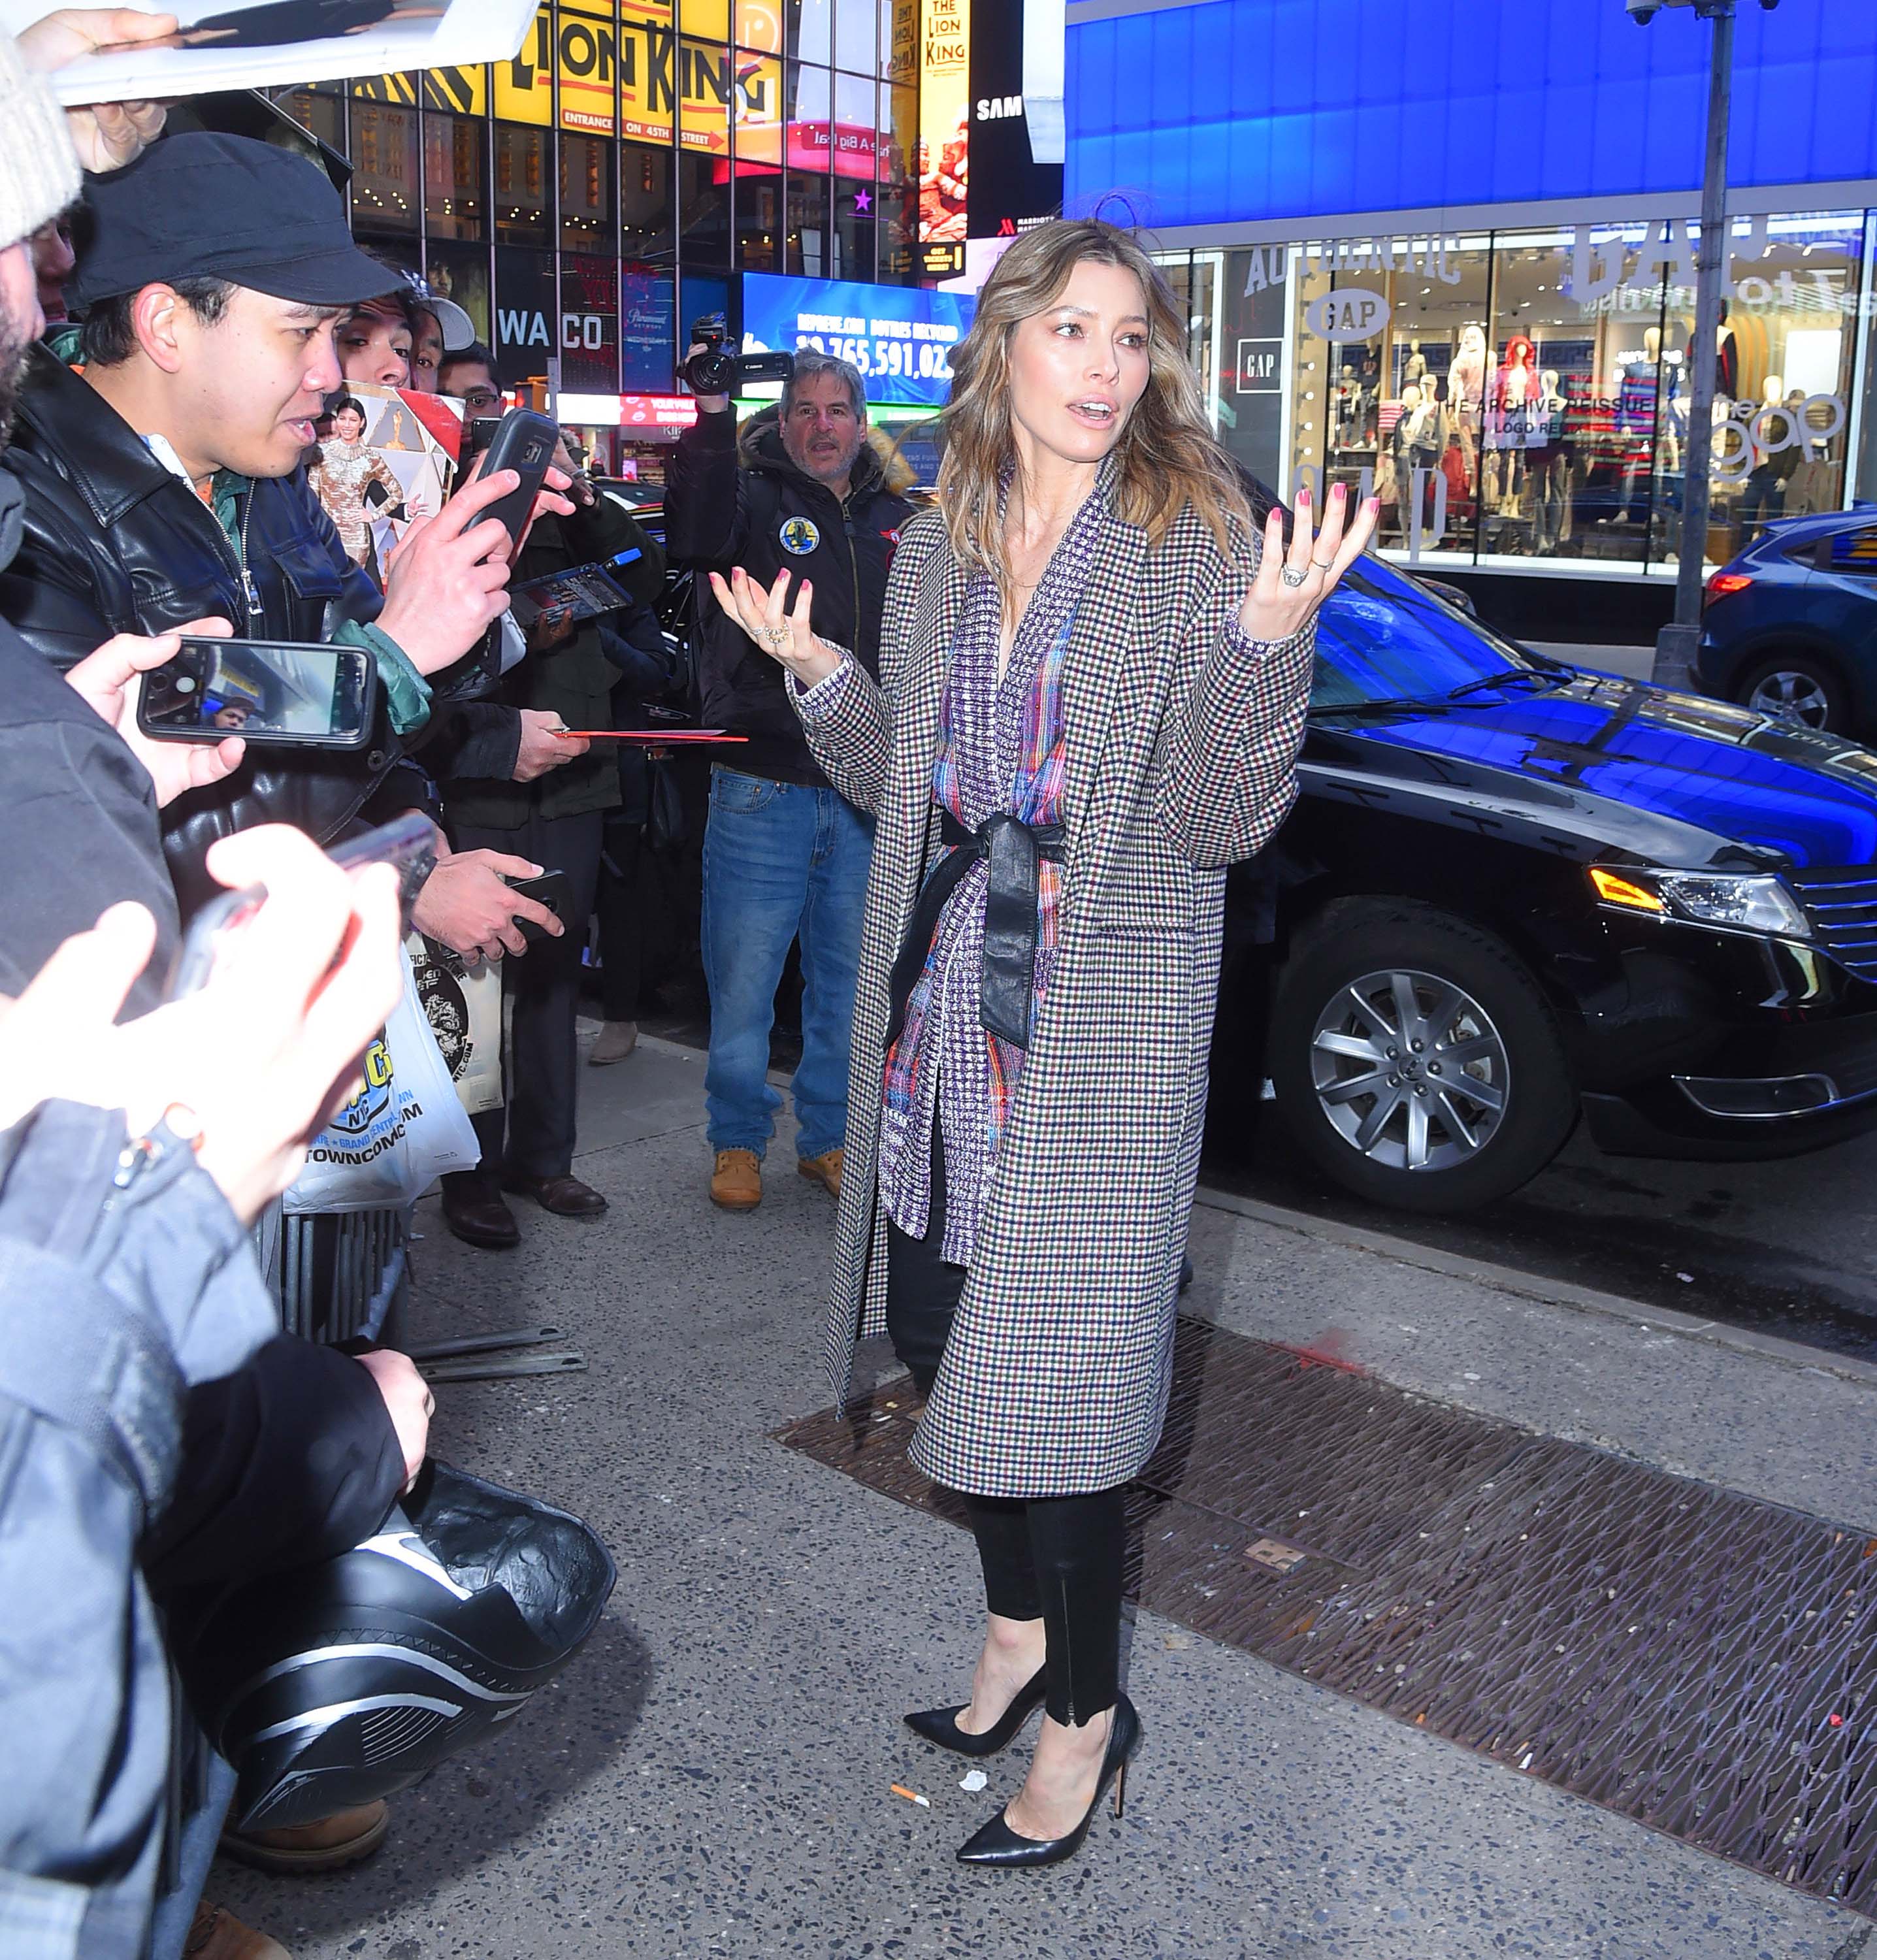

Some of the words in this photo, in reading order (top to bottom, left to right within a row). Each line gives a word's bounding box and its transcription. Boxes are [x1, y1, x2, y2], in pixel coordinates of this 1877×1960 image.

[933, 0, 956, 12] THE
[928, 17, 960, 38] LION
[926, 41, 965, 66] KING
[646, 20, 764, 114] KING
[564, 111, 613, 129] ENTRANCE
[626, 122, 642, 134] ON
[646, 127, 670, 139] 45TH
[681, 132, 709, 145] STREET
[1244, 234, 1461, 297] AUTHENTIC
[1320, 301, 1377, 331] GAP
[1247, 353, 1275, 378] GAP
[1475, 398, 1558, 414] ARCHIVE
[1494, 423, 1534, 434] LOGO
[339, 1134, 370, 1149] GRAND
